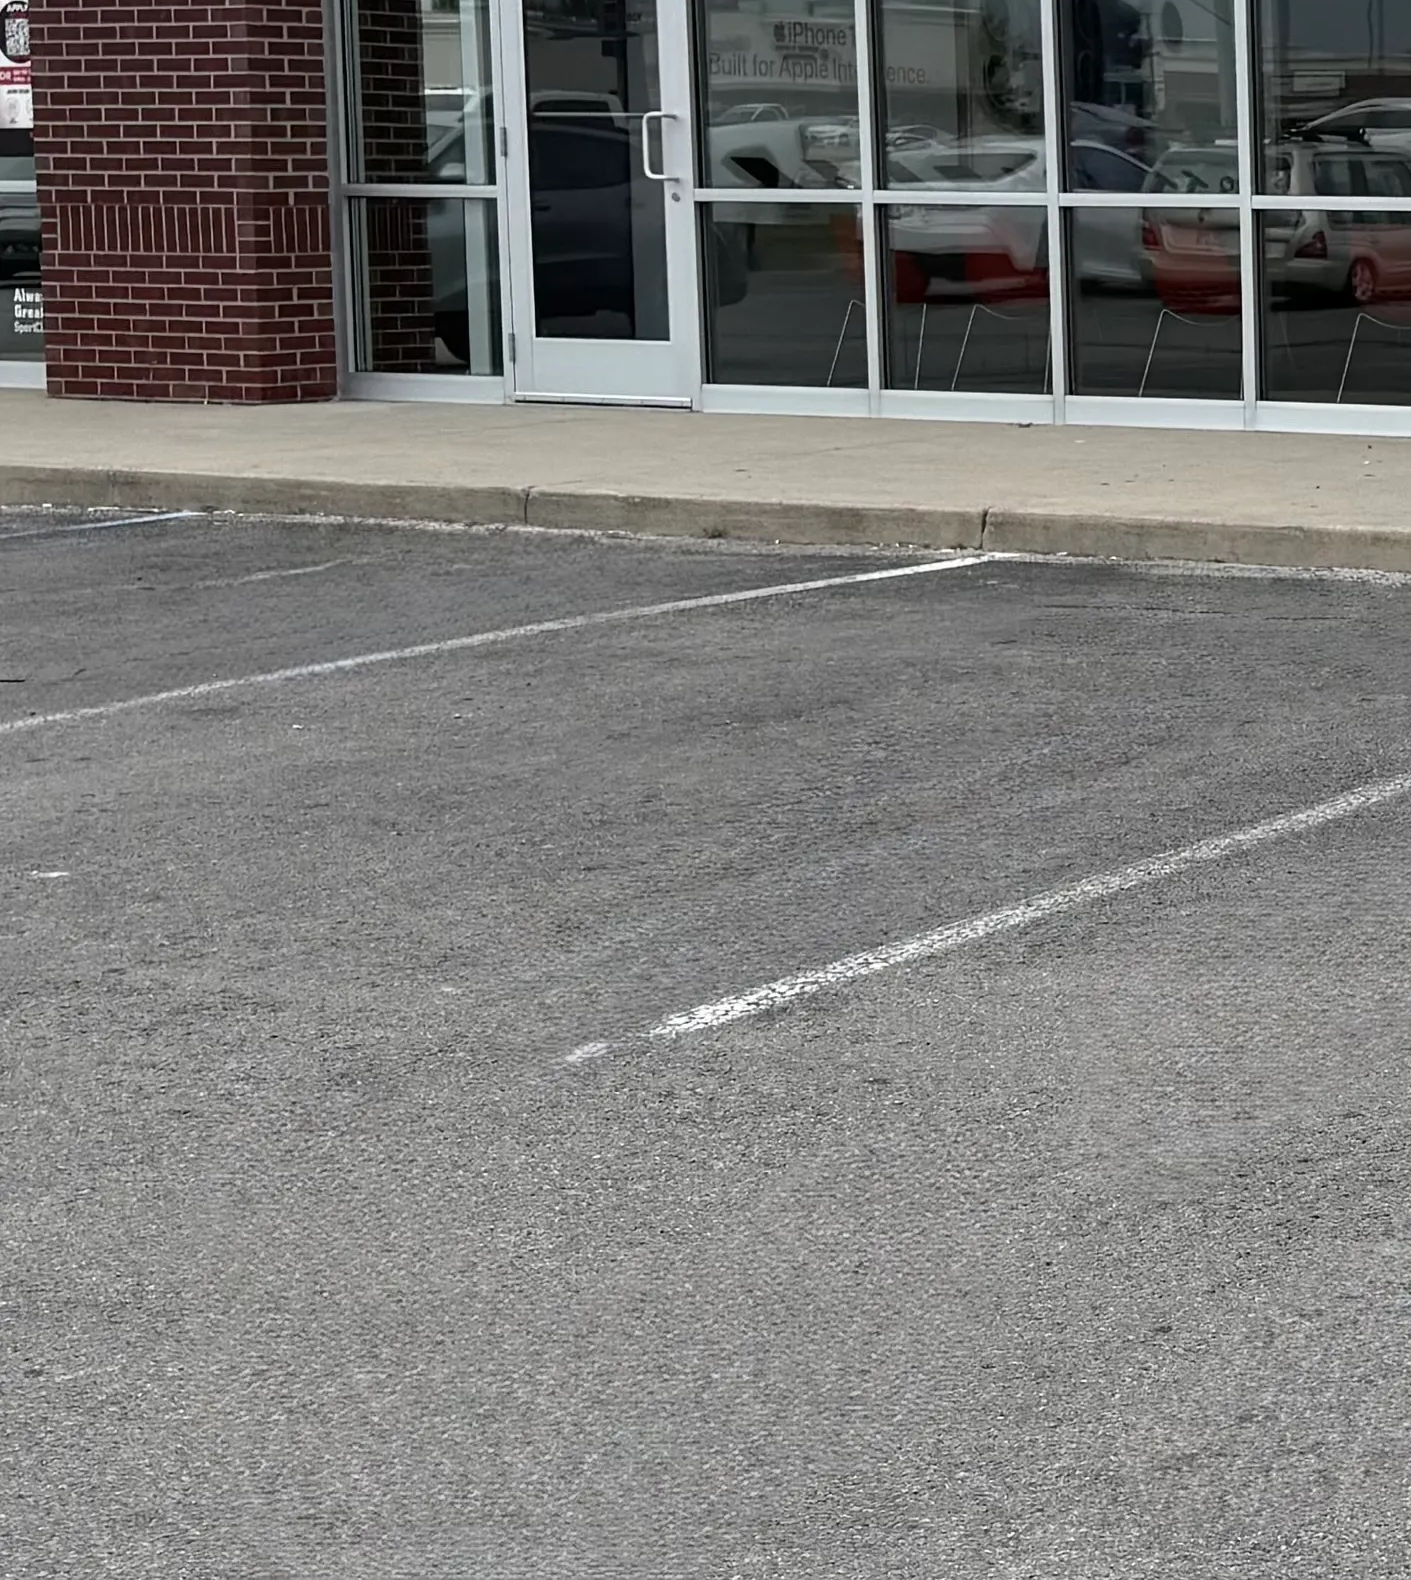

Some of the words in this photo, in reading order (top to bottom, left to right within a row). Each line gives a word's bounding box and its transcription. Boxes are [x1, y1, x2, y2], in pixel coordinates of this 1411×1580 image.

[787, 21, 847, 46] iPhone
[708, 52, 749, 76] Built
[753, 53, 777, 77] for
[778, 55, 830, 82] Apple
